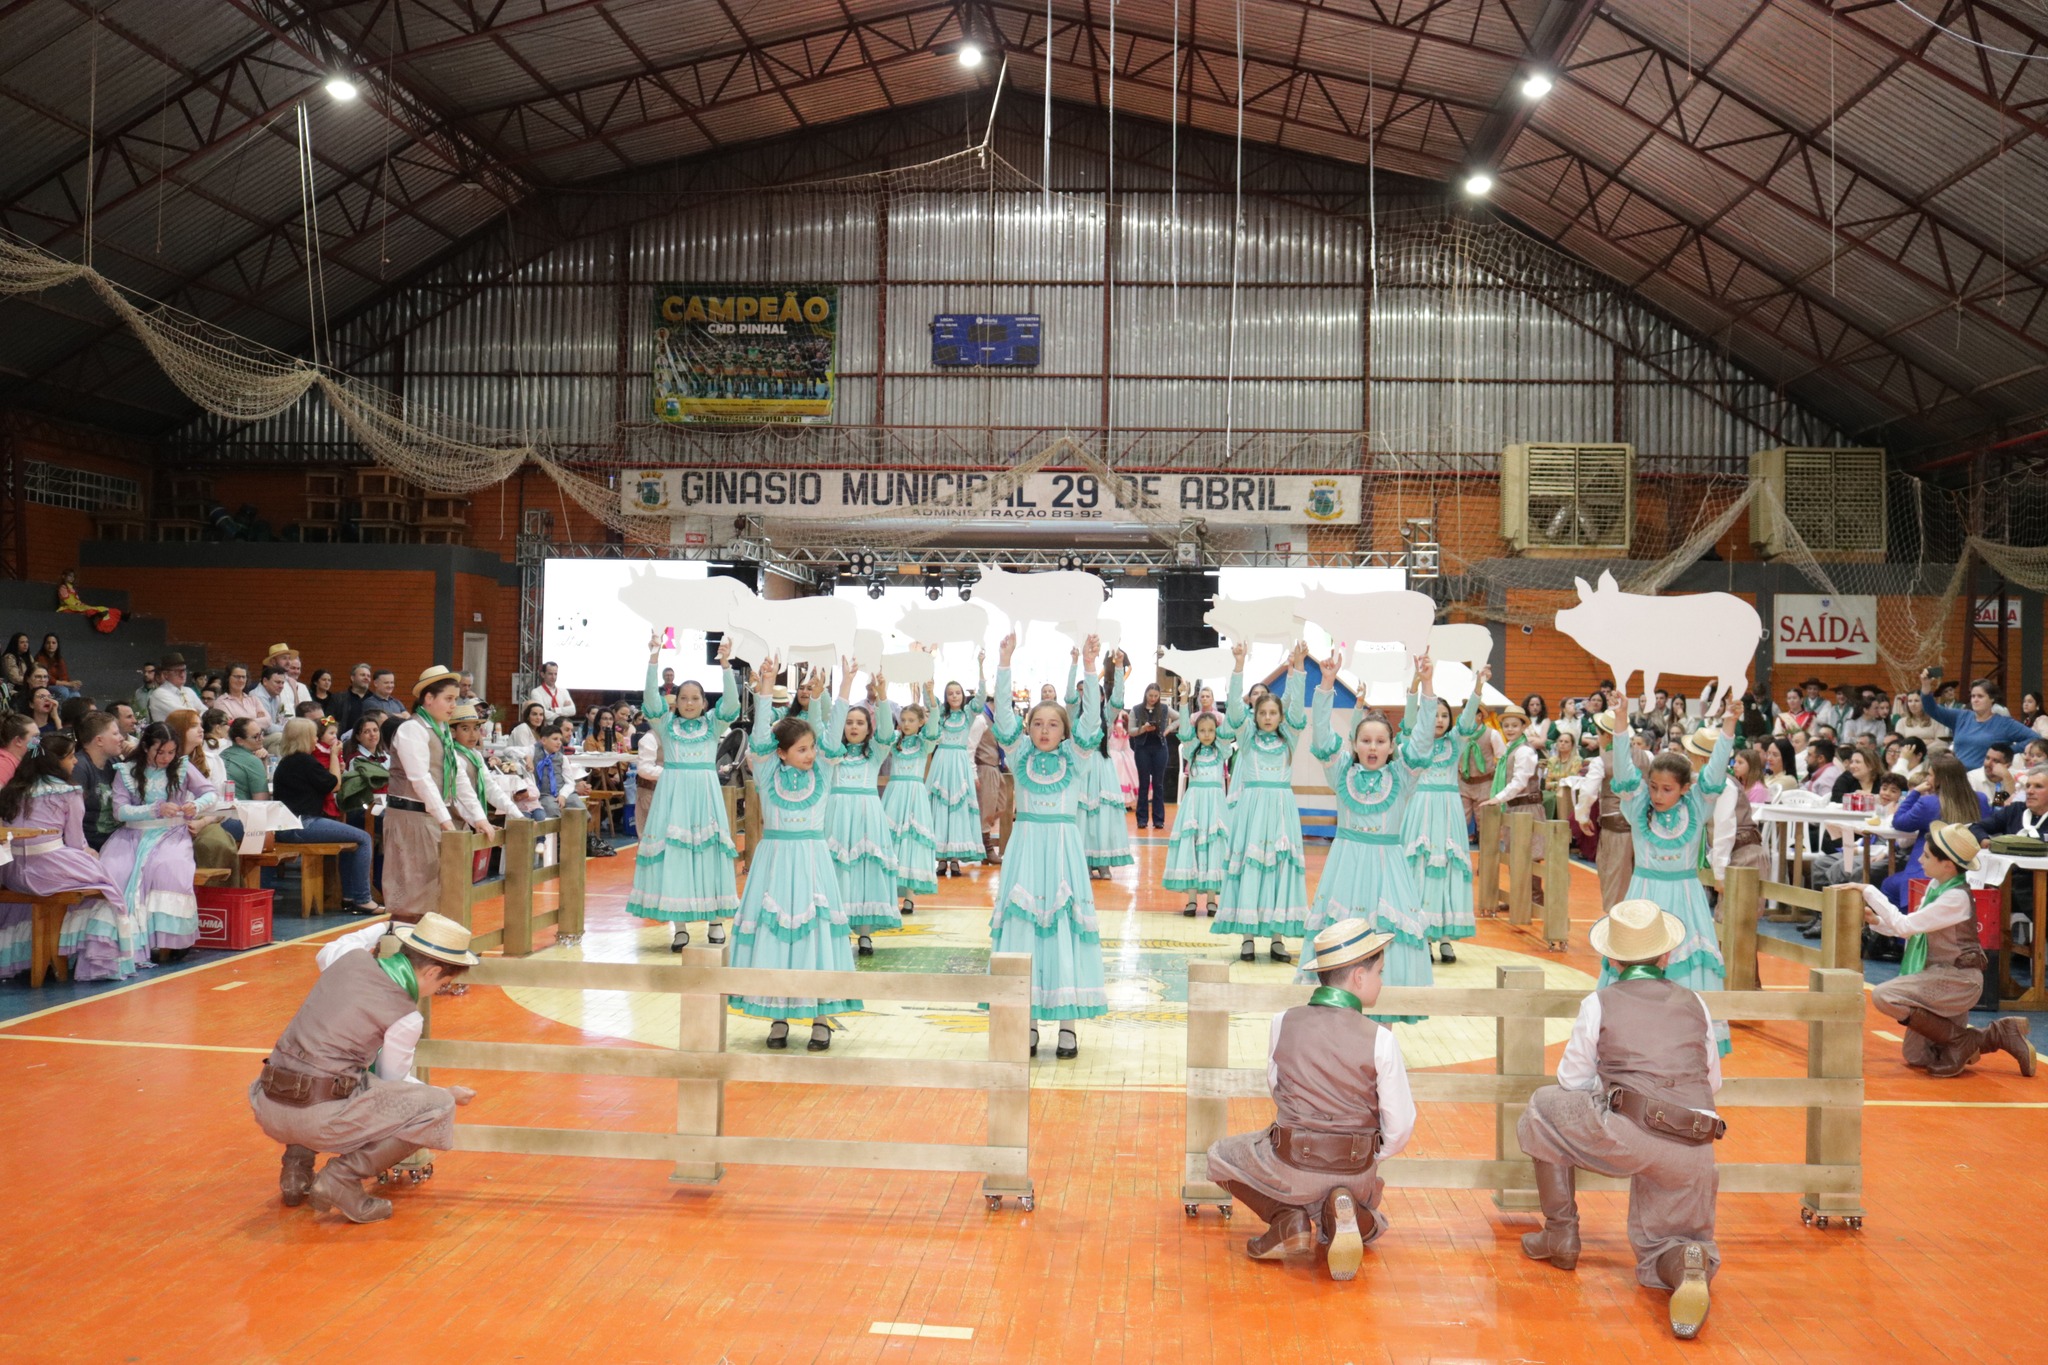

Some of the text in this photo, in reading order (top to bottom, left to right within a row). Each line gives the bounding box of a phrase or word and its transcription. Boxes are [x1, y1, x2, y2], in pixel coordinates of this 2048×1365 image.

[661, 291, 830, 323] CAMPEÃO
[707, 323, 788, 335] CMD PINHAL
[842, 471, 1037, 509] MUNICIPAL
[1051, 475, 1099, 509] 29
[1115, 476, 1162, 509] DE
[1180, 476, 1291, 512] ABRIL
[912, 508, 1103, 518] ADMINISTRAÇÃO 89-92
[1780, 612, 1870, 643] SAÍDA
